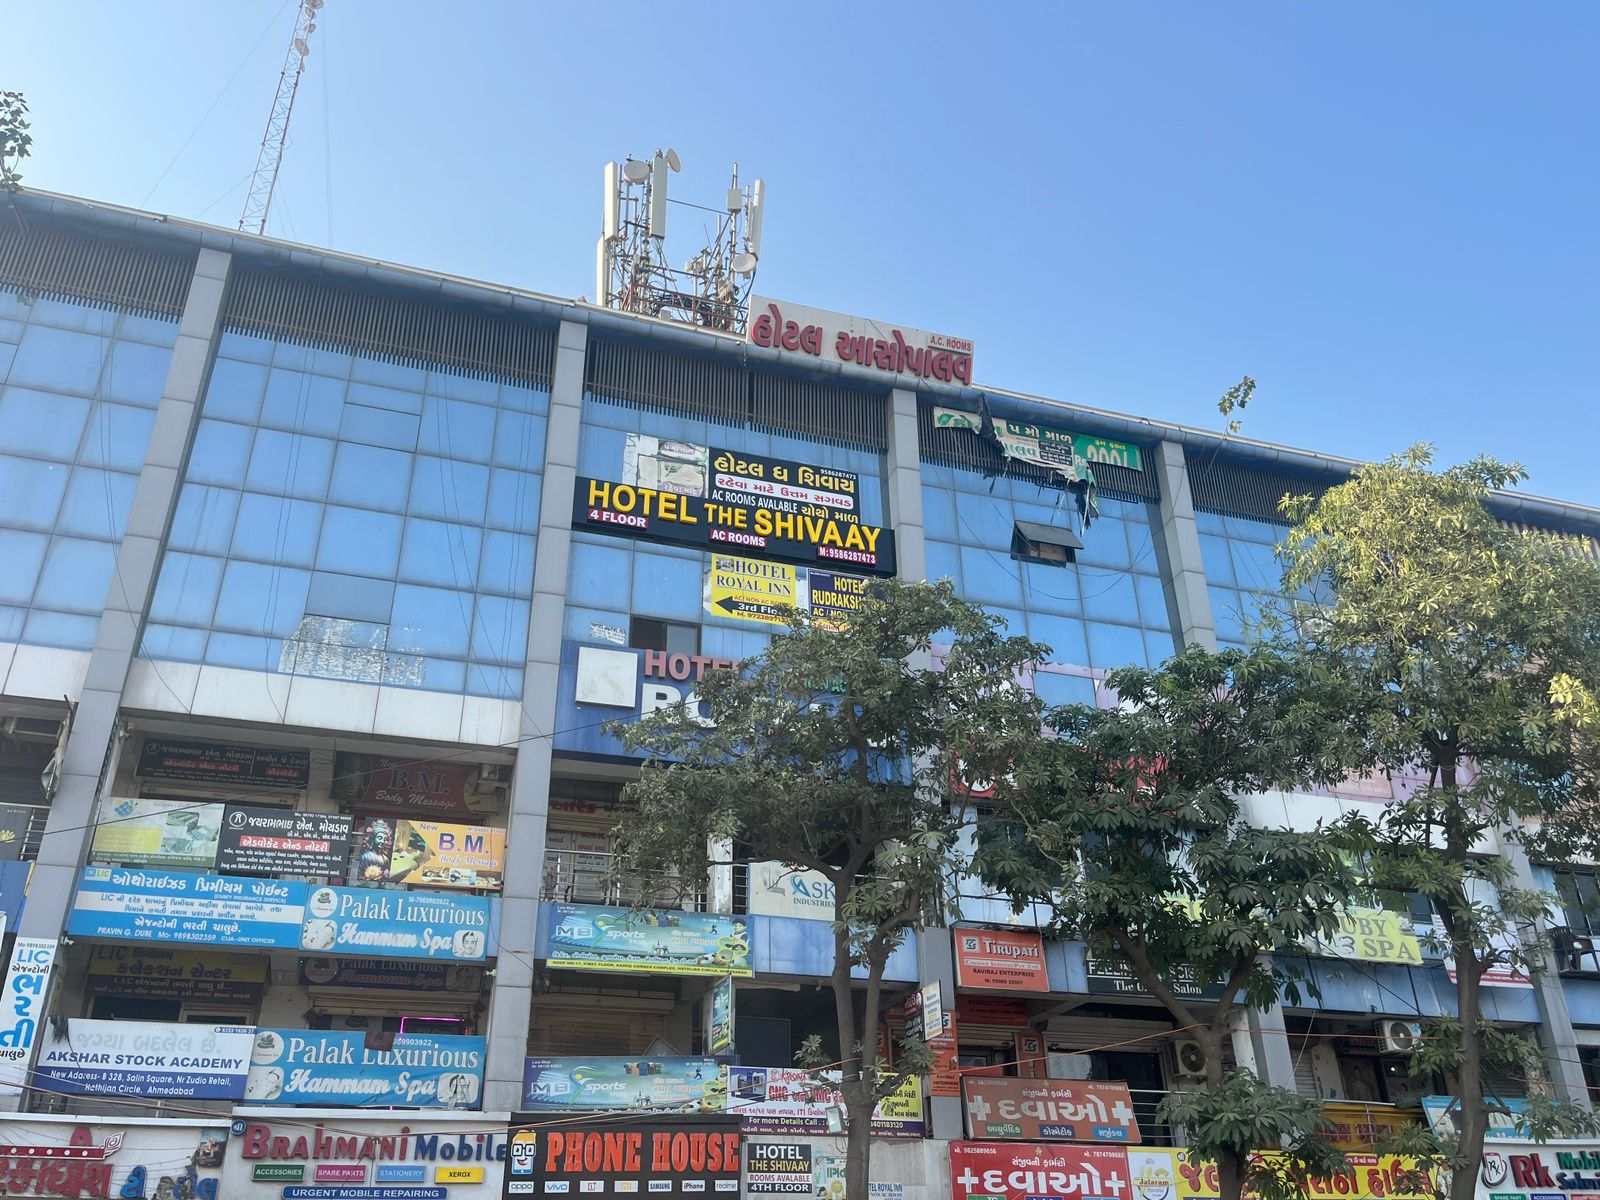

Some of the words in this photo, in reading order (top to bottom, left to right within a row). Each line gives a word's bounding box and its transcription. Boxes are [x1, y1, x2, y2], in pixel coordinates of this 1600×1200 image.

[752, 303, 823, 355] હોટલ
[835, 329, 972, 386] આસોપાલવ
[946, 339, 972, 352] ROOMS
[714, 451, 764, 478] હોટલ
[773, 466, 789, 482] ધ
[798, 465, 856, 494] શિવાય
[820, 468, 857, 480] 9586287473
[718, 476, 748, 490] રહેવા
[753, 482, 775, 494] માટે
[780, 487, 809, 500] ઉત્તમ
[813, 494, 852, 507] સગવડ
[712, 489, 724, 500] AC
[725, 491, 756, 507] ROOMS
[757, 498, 798, 514] AVALABLE
[588, 479, 698, 525] HOTEL
[703, 503, 748, 529] THE
[754, 508, 882, 553] SHIVAAY
[590, 509, 600, 521] 4
[601, 511, 647, 528] FLOOR
[834, 511, 860, 524] માળ
[711, 529, 726, 542] AC
[726, 531, 766, 548] ROOMS
[734, 559, 791, 581] HOTEL
[716, 575, 762, 592] ROYAL
[768, 581, 791, 596] INN
[834, 576, 864, 594] HOTEL
[738, 602, 756, 613] 3rd
[813, 607, 825, 617] AC
[375, 790, 405, 805] Body
[296, 816, 315, 831] એન.
[420, 823, 438, 831] New
[242, 836, 279, 849] એડવોકેટ
[281, 838, 302, 850] એન્ડ
[304, 841, 329, 852] નોટરી
[438, 832, 491, 855] B.M.
[96, 868, 110, 878] LIC
[100, 893, 114, 901] LIC
[793, 897, 836, 908] INDUSTRIES
[339, 894, 392, 920] Palak
[395, 898, 486, 926] Luxurious
[97, 926, 123, 935] PRAVIN
[182, 919, 207, 931] ભરતી
[1338, 914, 1388, 938] UBY
[605, 930, 648, 941] sports
[420, 928, 453, 957] Spa
[1363, 938, 1417, 961] SPA
[17, 949, 51, 964] LIC
[973, 968, 998, 976] RAVIRAJ
[999, 970, 1036, 978] ENTERPRISE
[1113, 980, 1134, 992] The
[1173, 983, 1203, 994] Salon
[286, 1037, 355, 1065] Palak
[361, 1042, 480, 1069] Luxurious
[46, 1050, 111, 1065] AKSHAR
[115, 1053, 167, 1067] STOCK
[169, 1055, 244, 1070] ACADEMY
[51, 1068, 68, 1079] New
[108, 1072, 124, 1082] 328,
[176, 1075, 185, 1084] Nr
[208, 1076, 232, 1087] Retail,
[118, 1084, 143, 1094] Circle,
[147, 1086, 195, 1096] Ahmedabad
[284, 1068, 391, 1095] Hammam
[393, 1071, 437, 1102] Spa
[584, 1081, 628, 1094] sports
[768, 1085, 789, 1102] CNC
[997, 1093, 1109, 1123] દવાઓ
[749, 1116, 761, 1124] For
[761, 1117, 780, 1125] more
[780, 1117, 804, 1126] Details
[805, 1118, 818, 1126] Call
[413, 1132, 507, 1162] Mobile
[545, 1131, 642, 1172] PHONE
[651, 1132, 739, 1172] HOUSE
[755, 1144, 804, 1160] HOTEL
[750, 1159, 769, 1171] THE
[770, 1160, 810, 1172] SHIVAAY
[1011, 1155, 1041, 1168] સંજીવની
[255, 1168, 303, 1177] ACCESSORIES
[318, 1168, 340, 1177] SPARE
[341, 1168, 365, 1178] PARTS
[379, 1168, 424, 1178] STATIONERY
[447, 1170, 472, 1179] XEROX
[1508, 1152, 1557, 1188] Rk
[749, 1174, 776, 1183] ROOMS
[776, 1174, 811, 1183] AVALABLE
[982, 1162, 1102, 1195] દવાઓ
[1139, 1178, 1170, 1186] Jalaram
[511, 1183, 533, 1192] oppo
[547, 1183, 568, 1191] vivo
[649, 1183, 671, 1191] SAMSUNG
[683, 1182, 704, 1190] iPhone
[716, 1182, 737, 1190] realme
[751, 1183, 772, 1192] 4TH
[774, 1183, 809, 1192] FLOOR
[878, 1183, 893, 1193] ROYAL
[893, 1184, 903, 1193] INN
[292, 1187, 338, 1198] URGENT
[339, 1187, 381, 1198] MOBILE
[382, 1188, 440, 1199] REPAIRING
